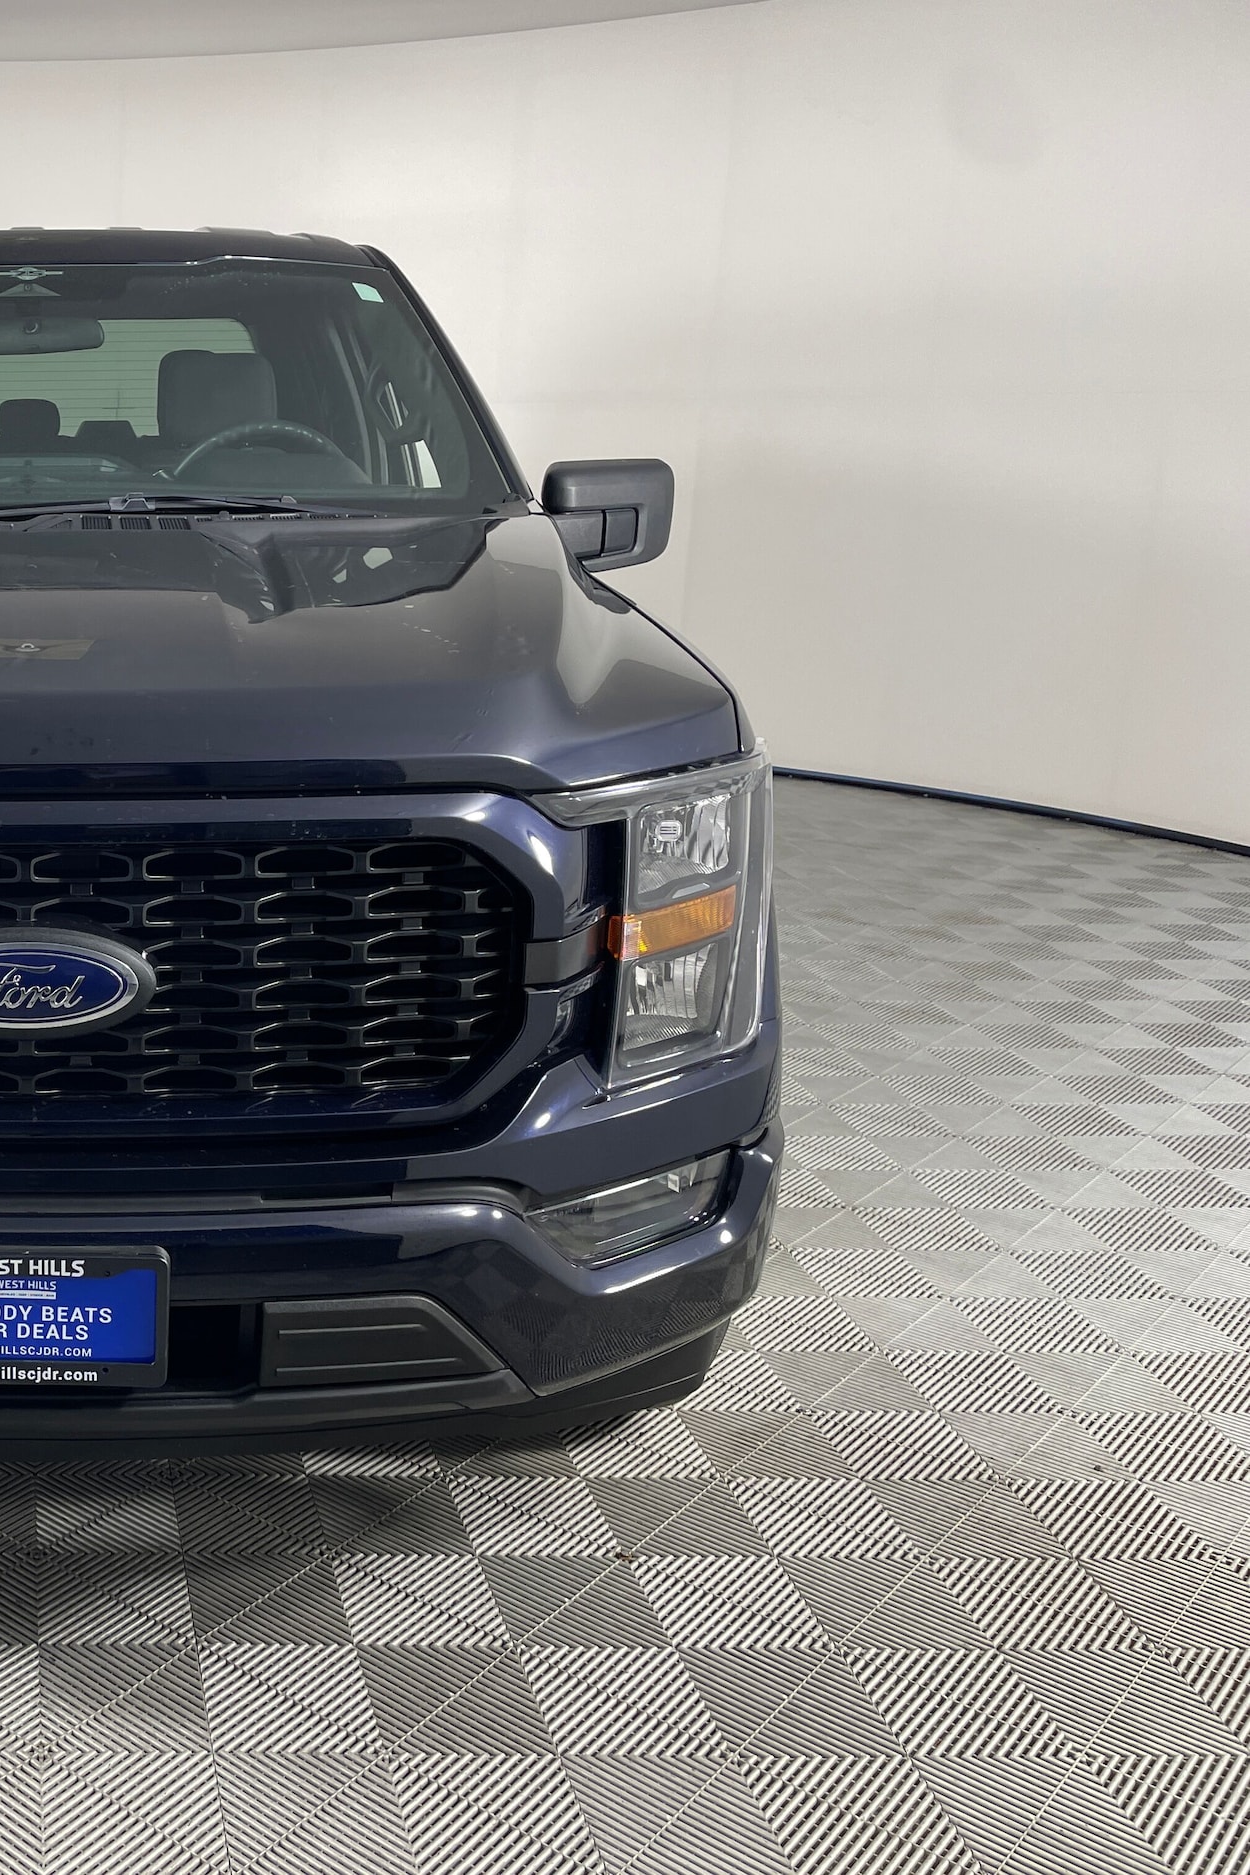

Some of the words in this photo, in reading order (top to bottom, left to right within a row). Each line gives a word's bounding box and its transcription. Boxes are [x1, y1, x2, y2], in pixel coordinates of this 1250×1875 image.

[28, 1259, 85, 1277] HILLS
[27, 1280, 57, 1291] HILLS
[41, 1307, 113, 1324] BEATS
[17, 1324, 89, 1341] DEALS
